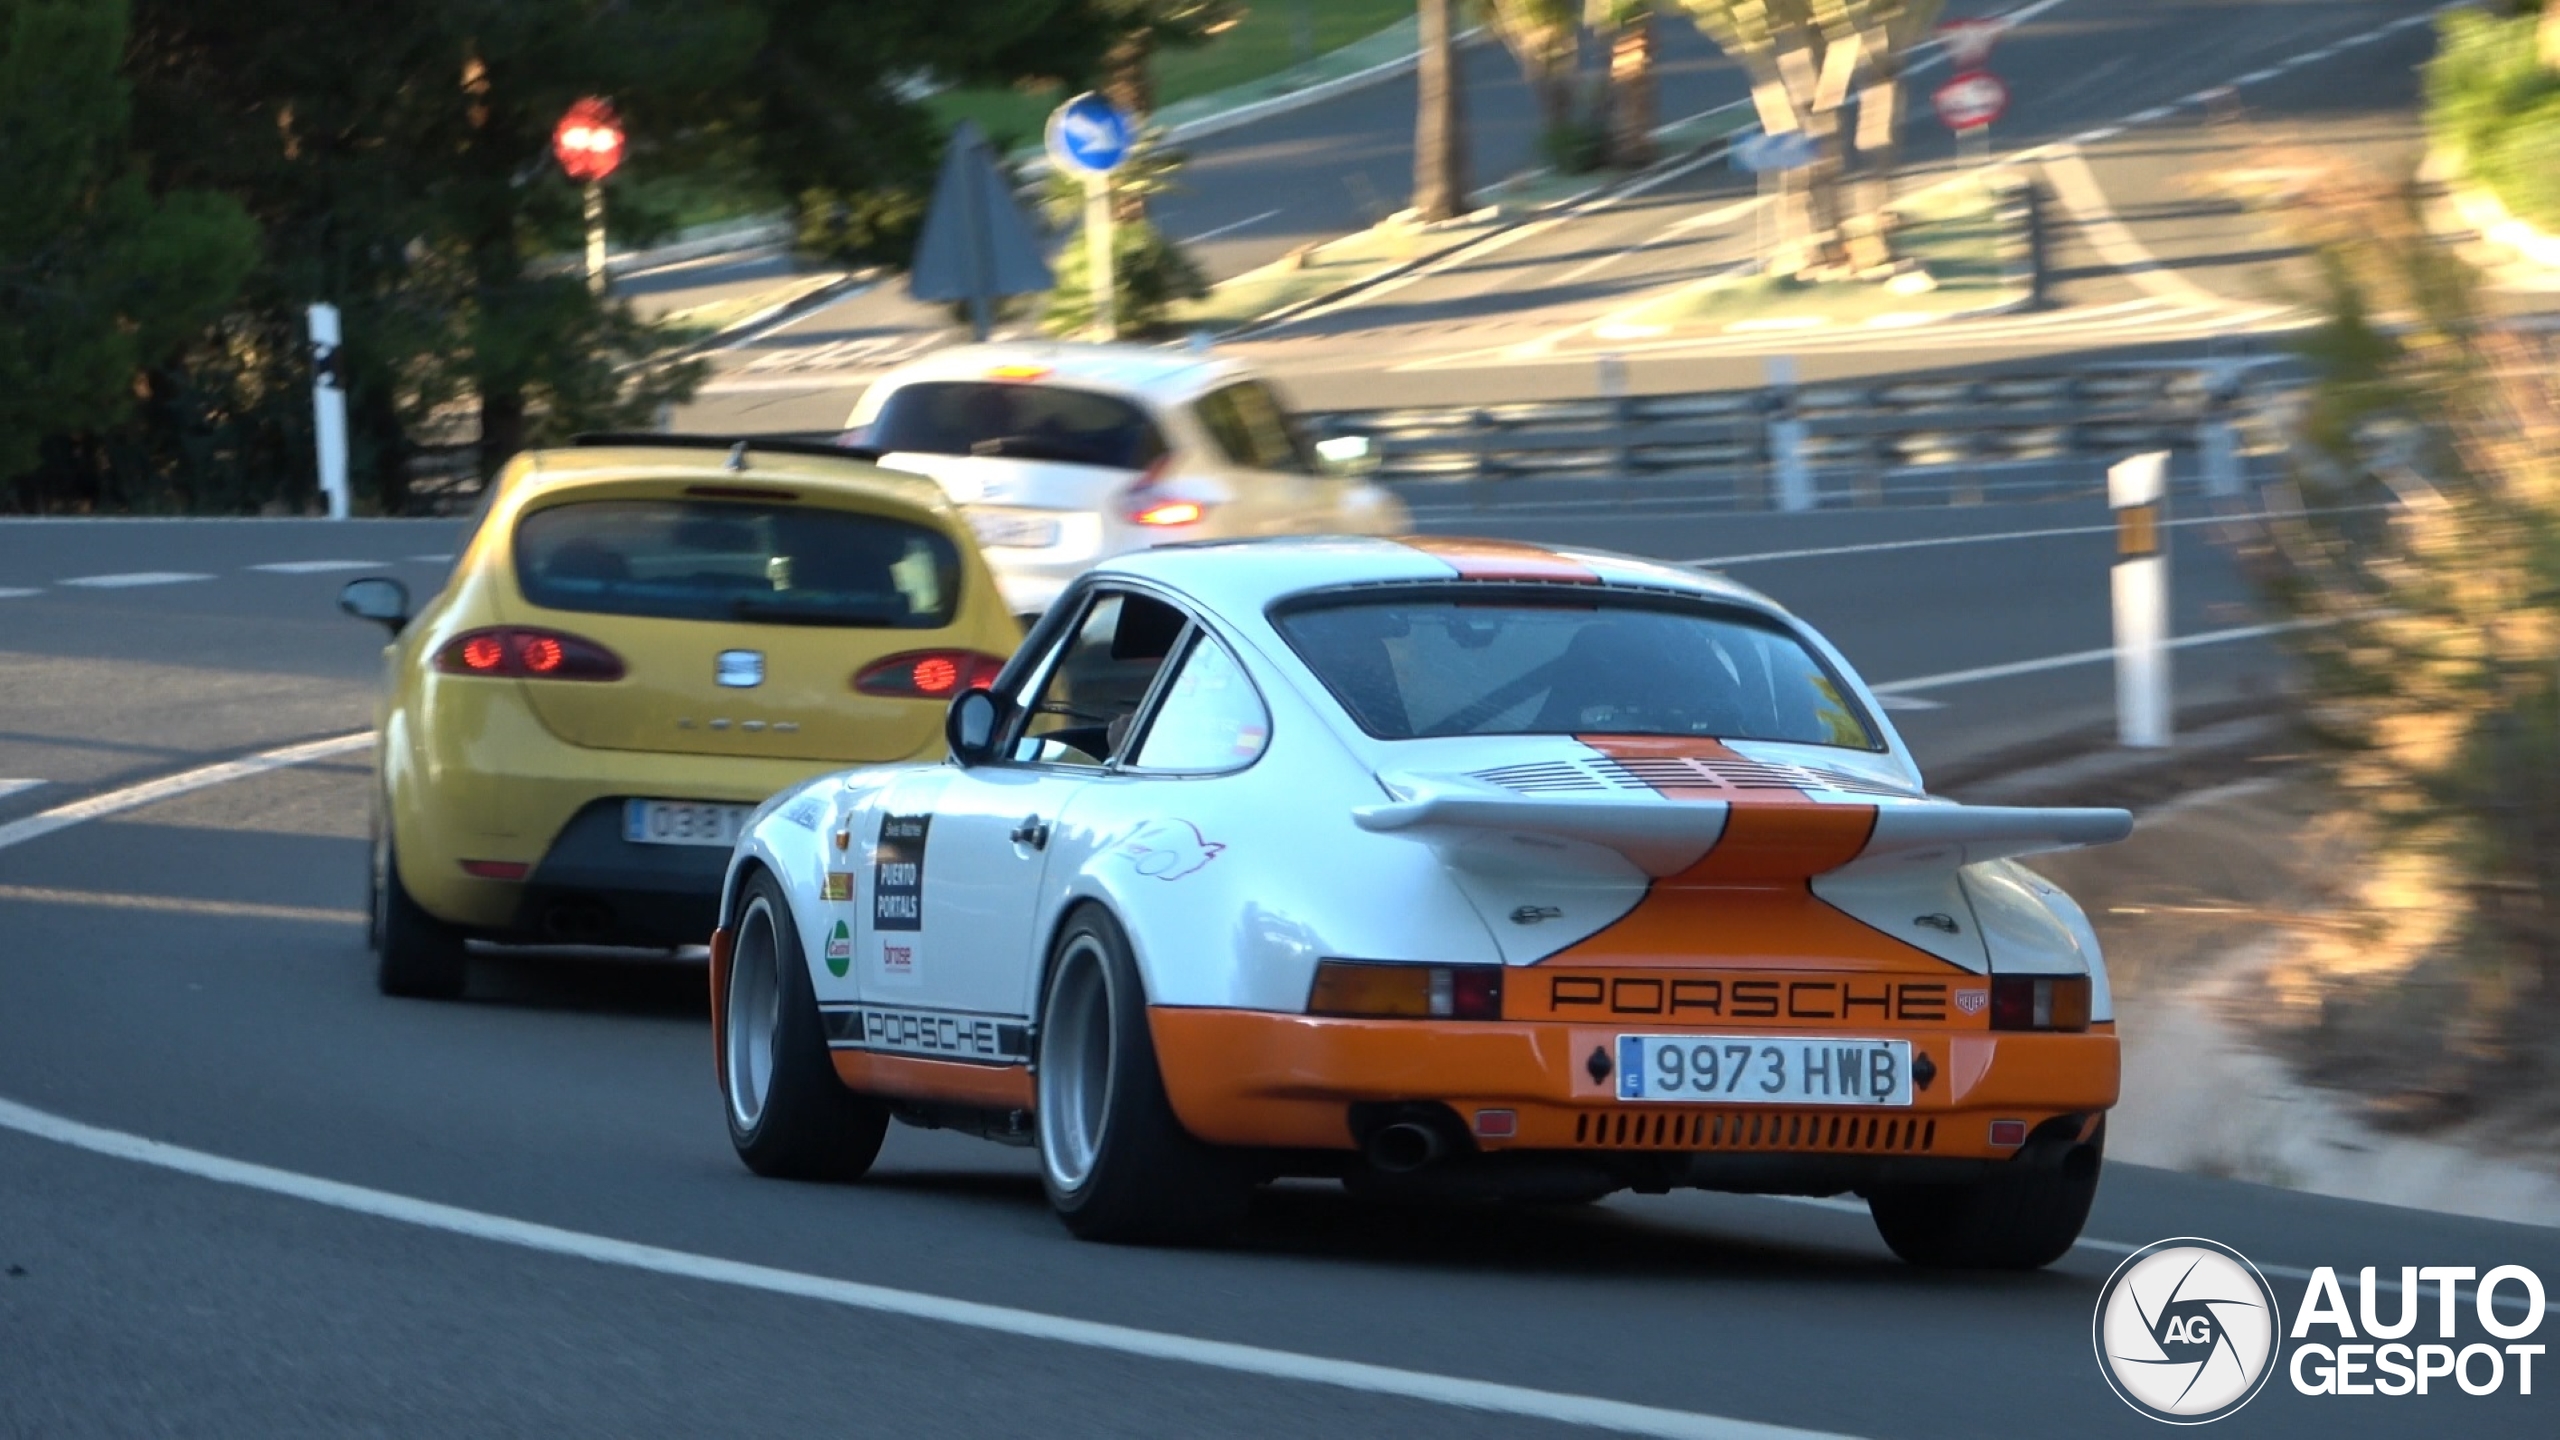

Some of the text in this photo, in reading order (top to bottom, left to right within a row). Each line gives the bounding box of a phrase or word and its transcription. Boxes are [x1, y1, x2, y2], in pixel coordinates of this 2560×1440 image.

[880, 863, 917, 886] PUERTO
[877, 895, 918, 918] PORTALS
[883, 938, 911, 965] brose
[1551, 976, 1947, 1021] PORSCHE
[866, 1012, 995, 1054] PORSCHE
[1656, 1044, 1896, 1098] 9973 HWB
